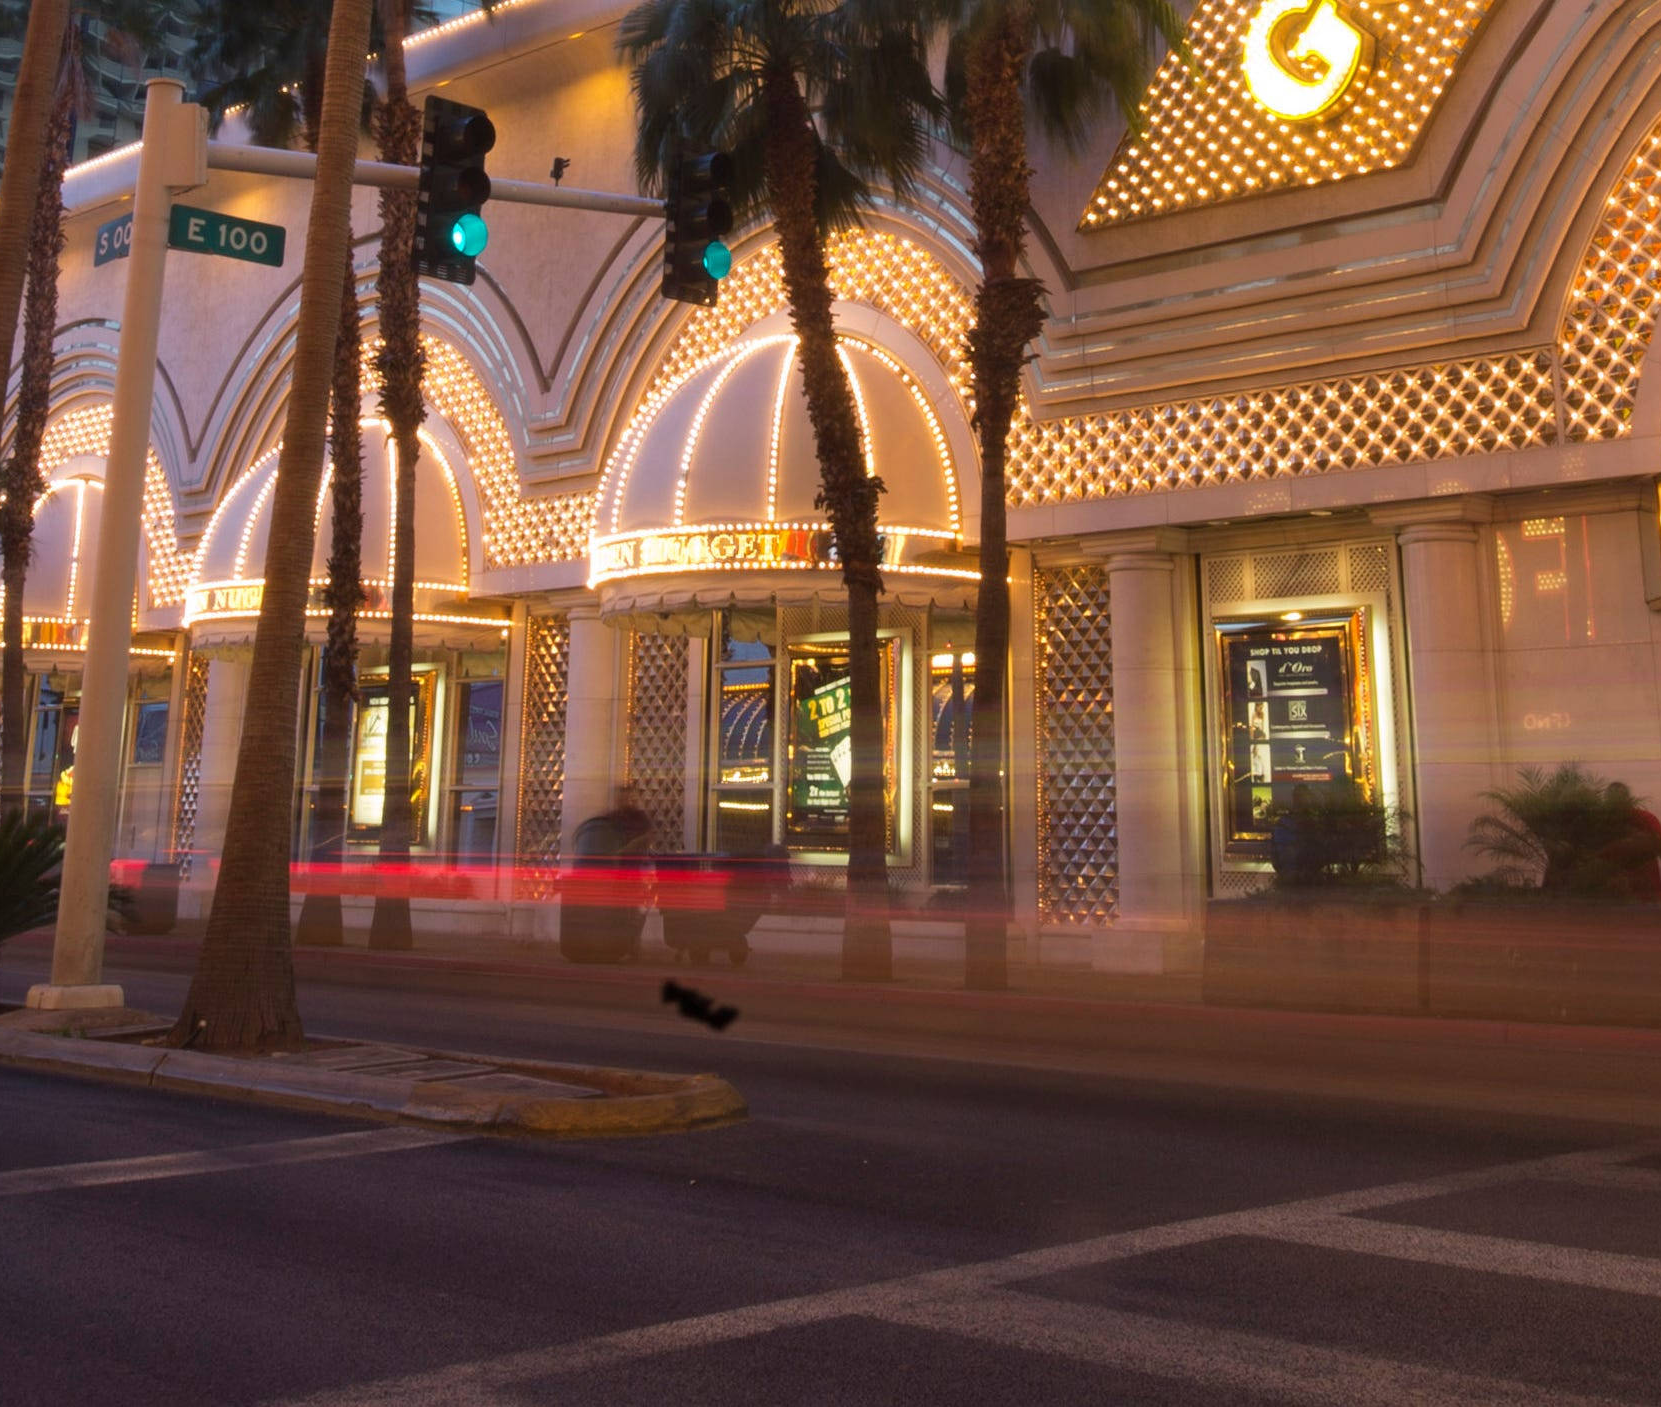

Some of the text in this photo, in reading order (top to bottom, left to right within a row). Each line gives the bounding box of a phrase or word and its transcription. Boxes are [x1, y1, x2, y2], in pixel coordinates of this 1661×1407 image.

[99, 233, 108, 255] S
[188, 217, 268, 254] E 100
[1250, 648, 1270, 656] SHOP
[1284, 646, 1300, 655] YOU
[1301, 645, 1322, 654] DROP
[808, 699, 818, 721] 2
[819, 695, 835, 716] TO
[836, 687, 847, 710] 2
[1290, 703, 1308, 719] SIX
